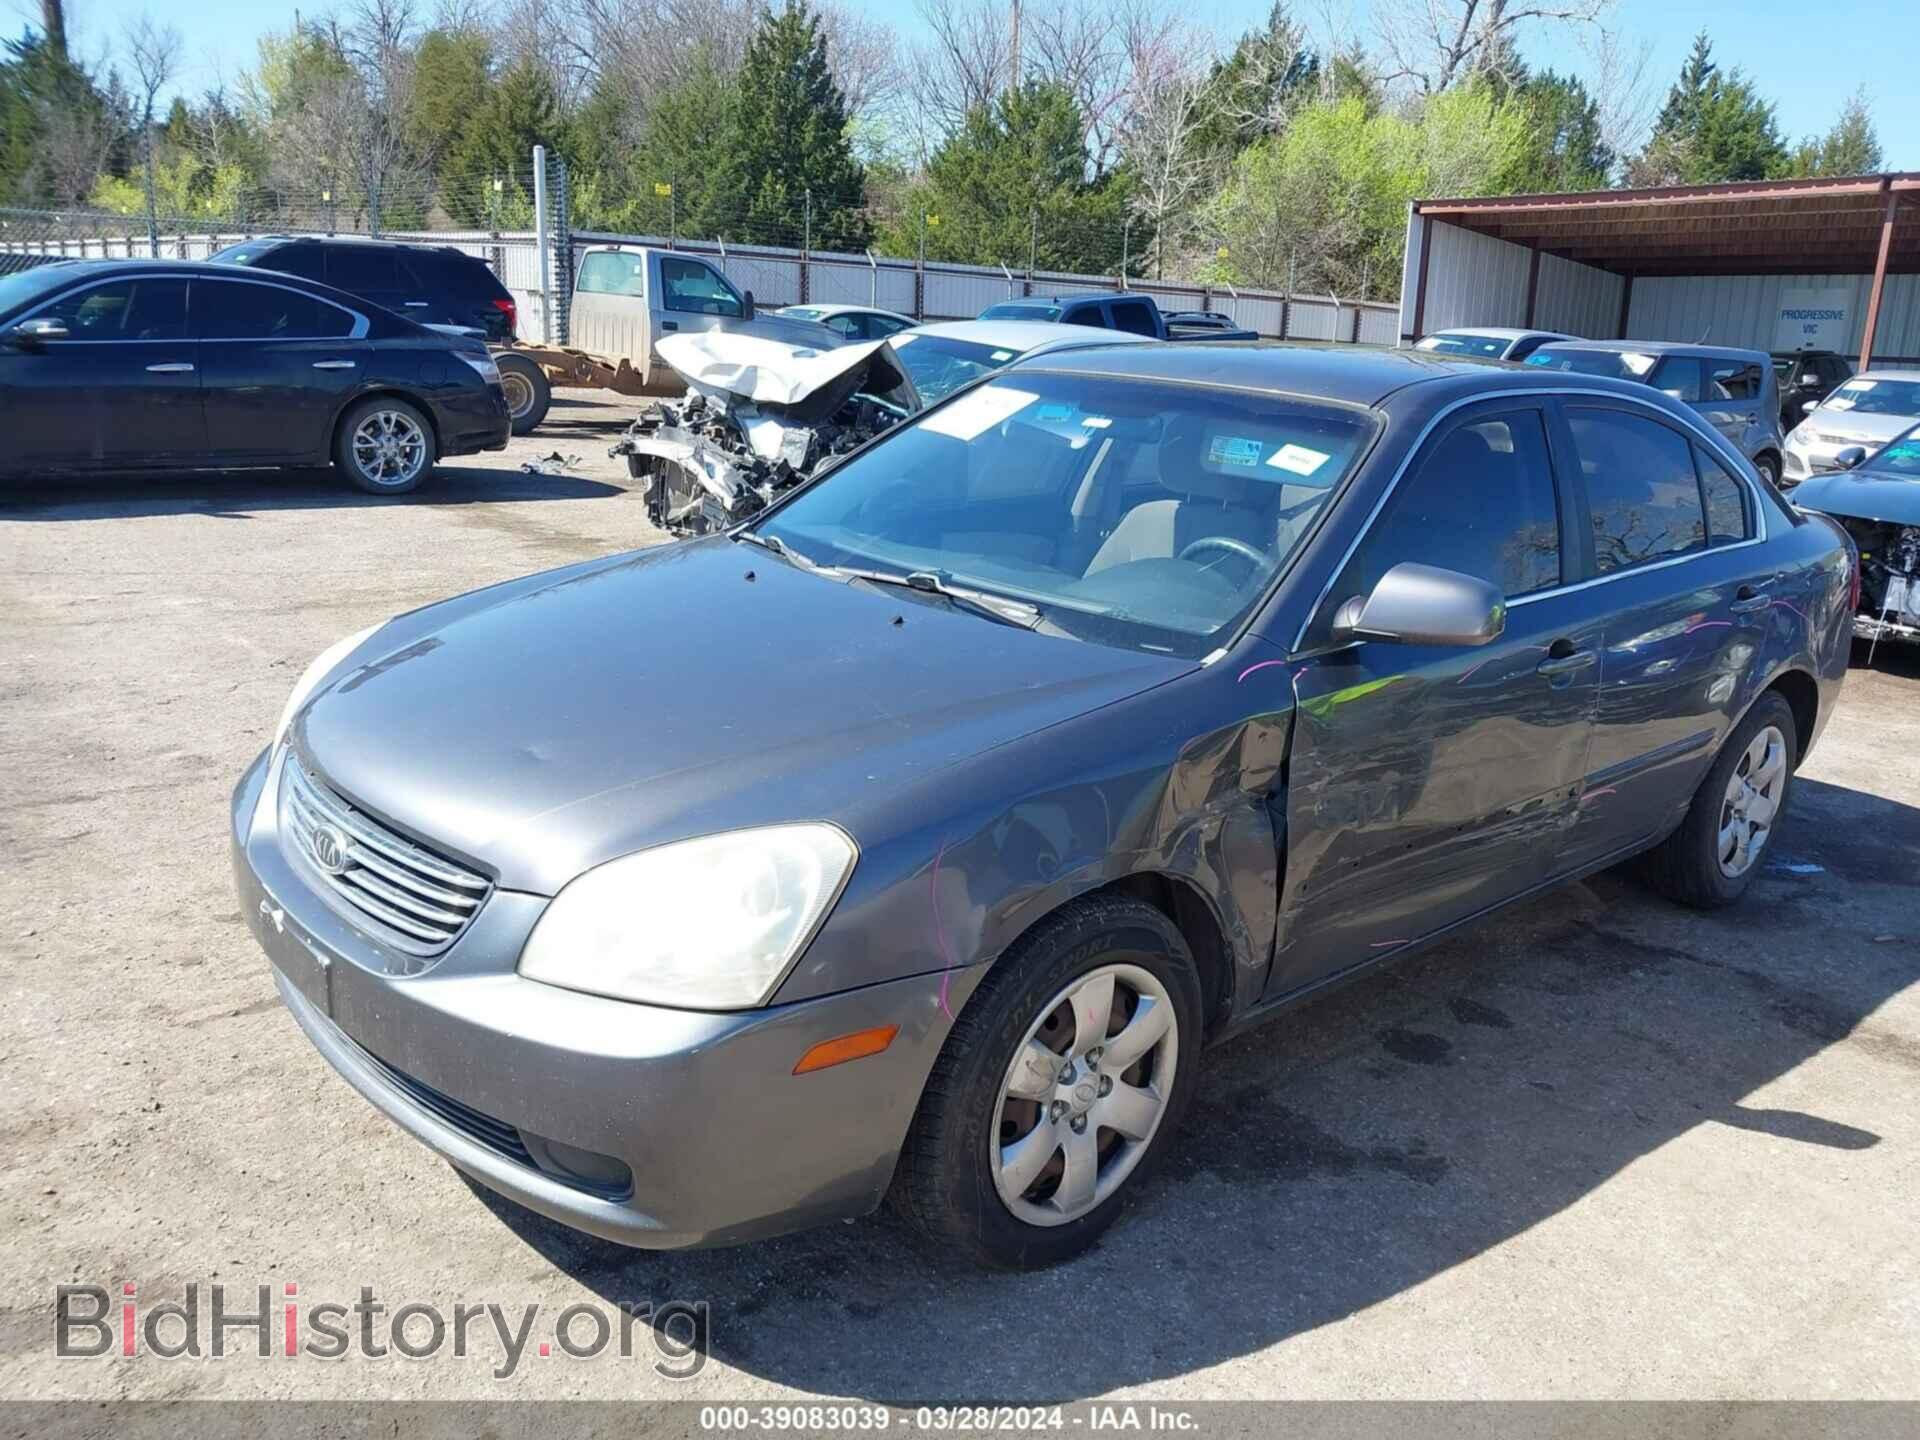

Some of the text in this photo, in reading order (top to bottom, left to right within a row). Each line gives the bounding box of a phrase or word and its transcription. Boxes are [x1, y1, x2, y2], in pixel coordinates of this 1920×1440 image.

[1781, 308, 1845, 320] PROGRESSIVE
[1803, 323, 1818, 334] VIC
[315, 831, 337, 866] KIA
